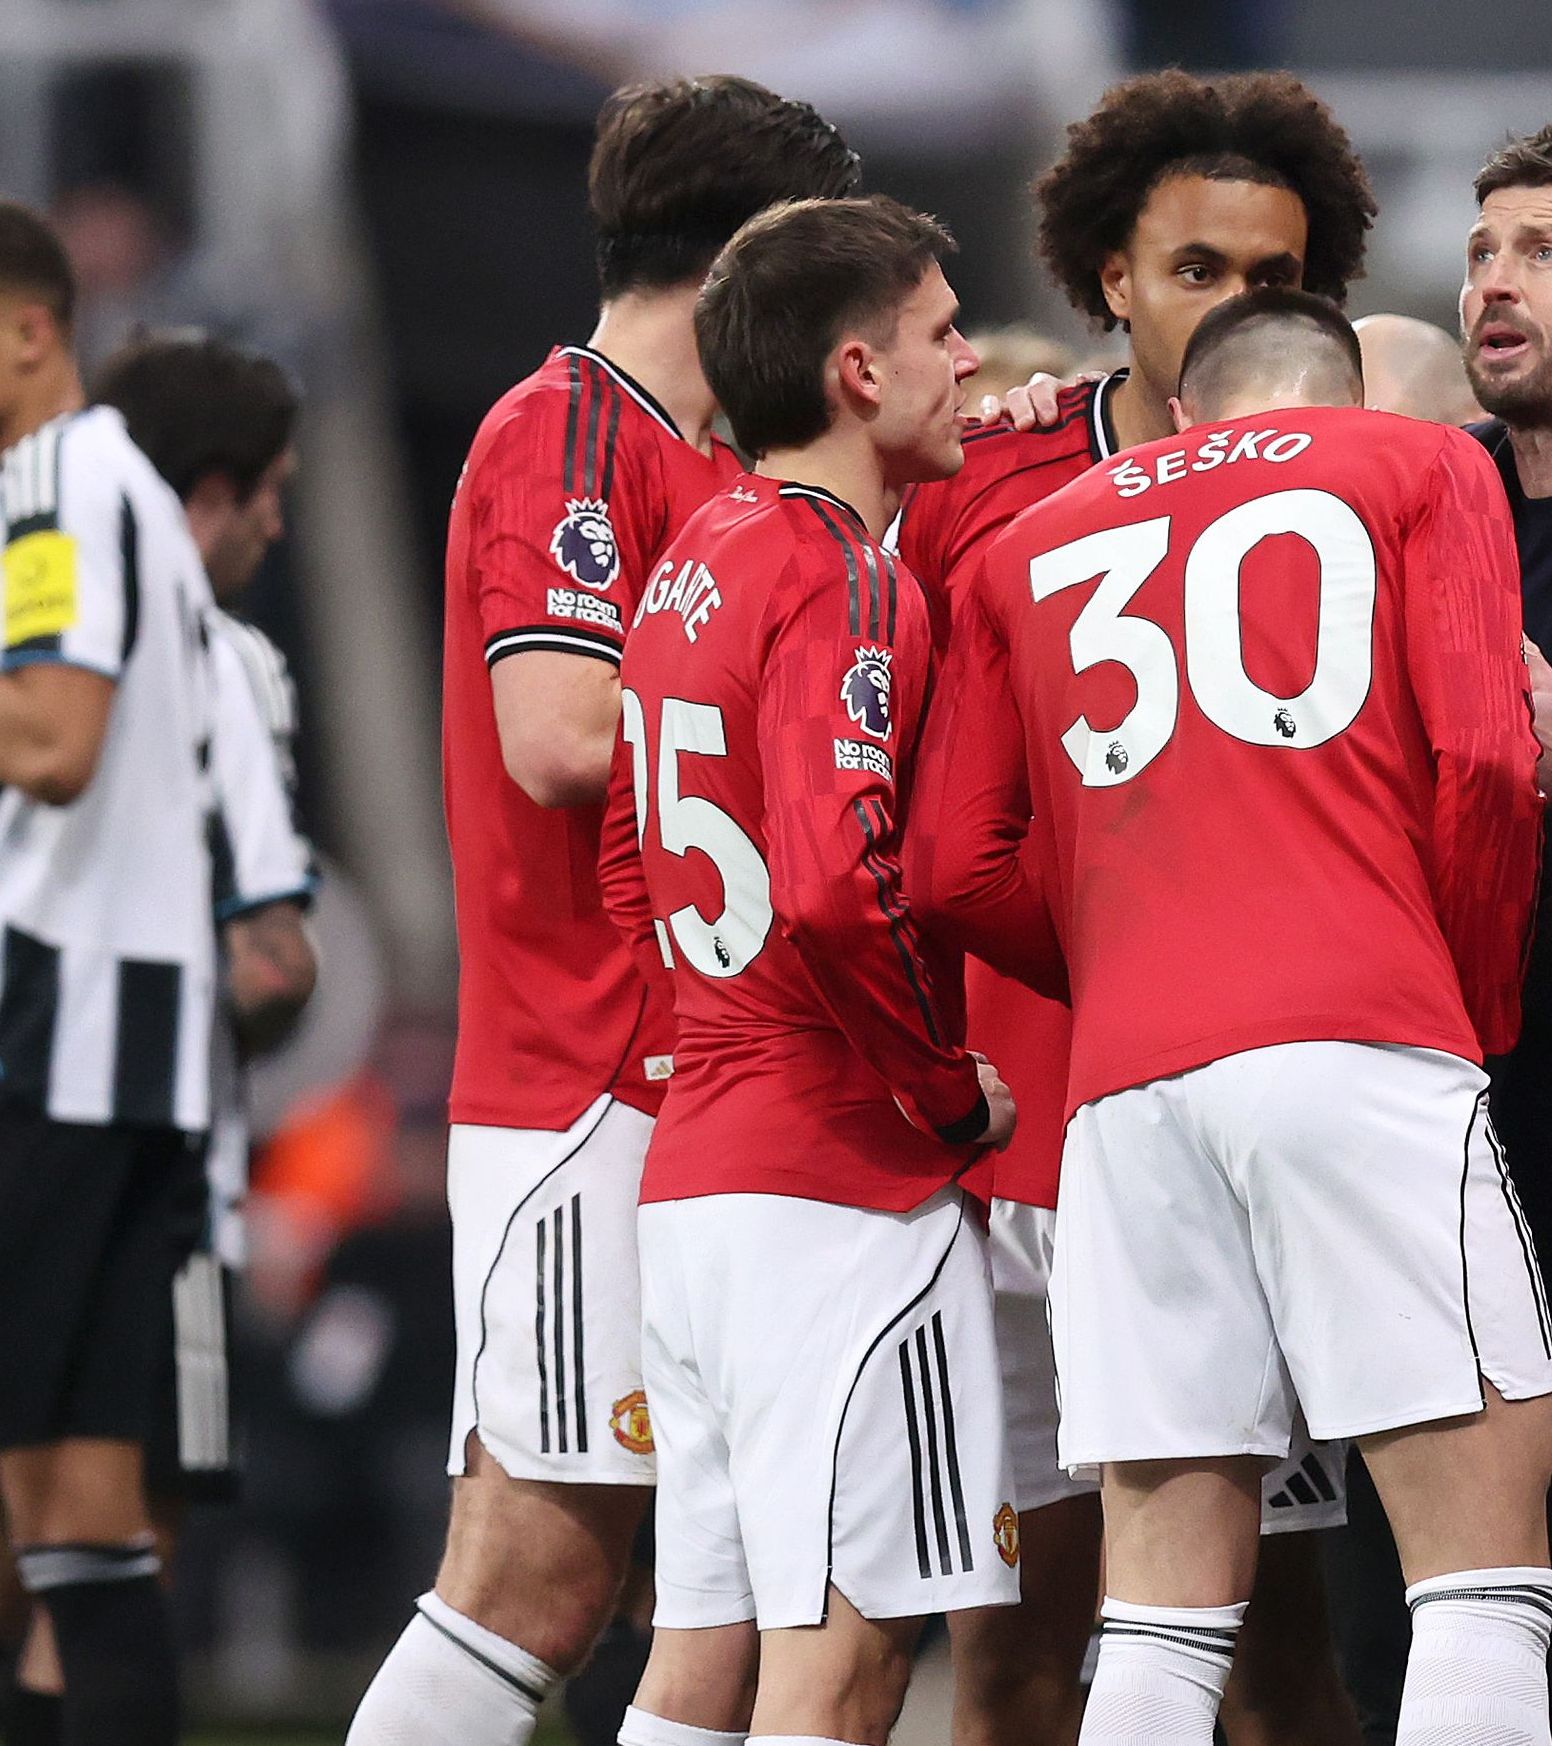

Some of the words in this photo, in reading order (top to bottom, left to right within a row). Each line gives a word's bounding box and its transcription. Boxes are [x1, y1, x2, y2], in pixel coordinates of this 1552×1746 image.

[1106, 429, 1312, 498] ŠEŠKO
[547, 588, 576, 605] No
[1029, 488, 1376, 788] 30
[833, 738, 861, 755] No
[835, 755, 862, 769] for
